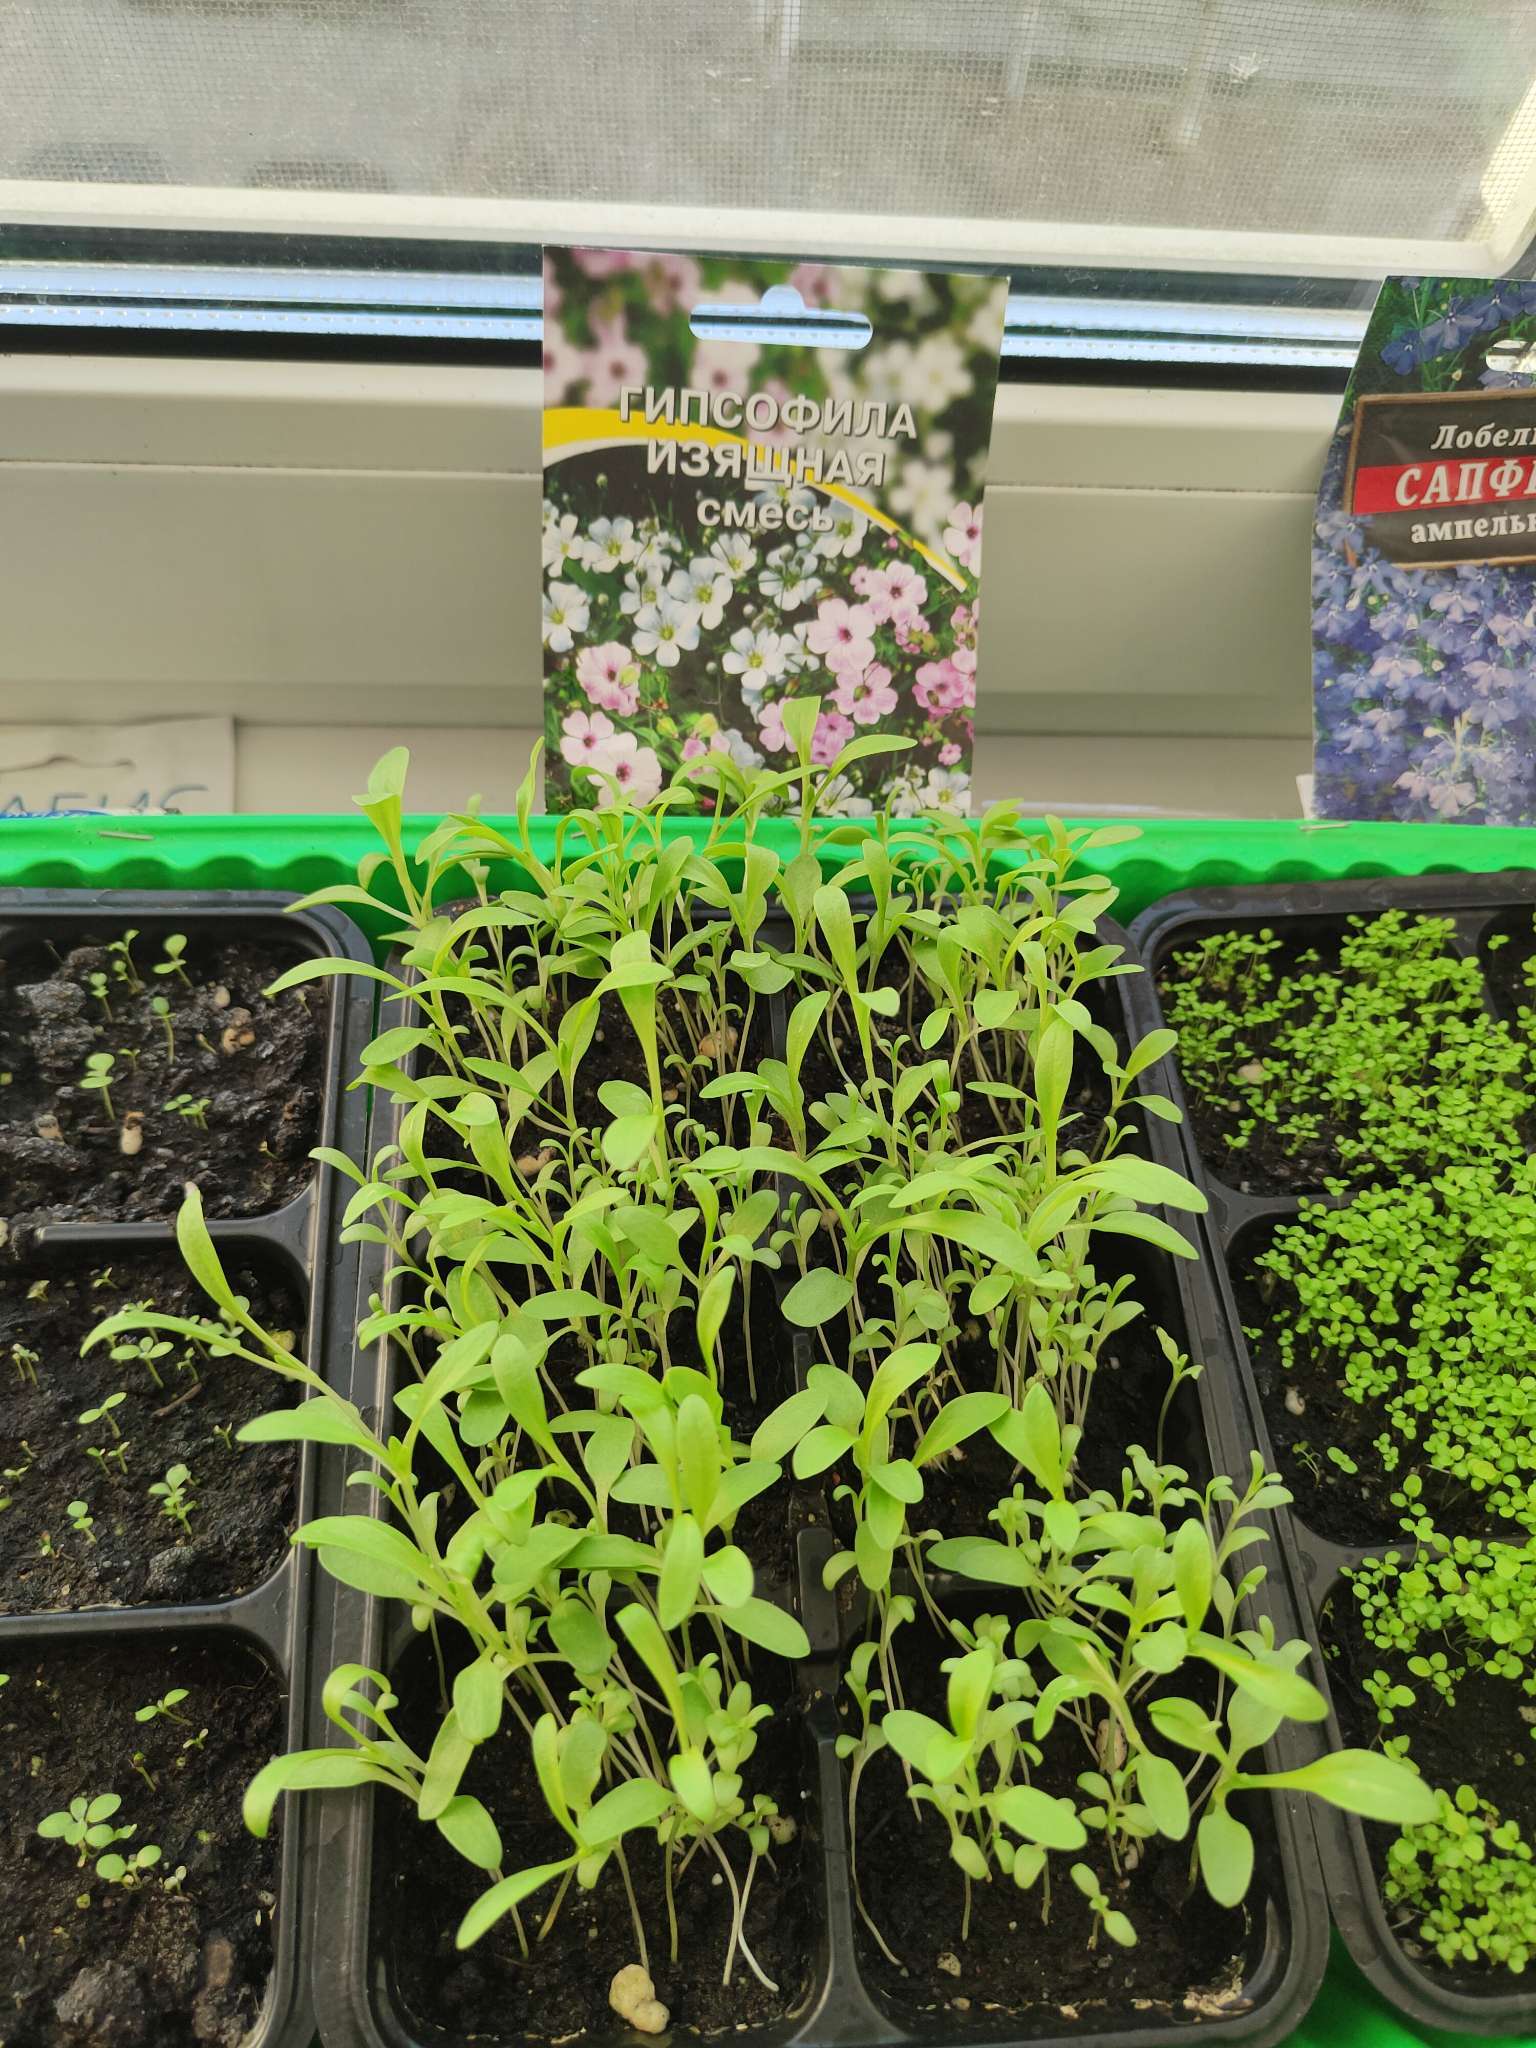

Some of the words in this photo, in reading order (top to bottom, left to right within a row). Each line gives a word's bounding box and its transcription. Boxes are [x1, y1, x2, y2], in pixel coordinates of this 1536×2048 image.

[619, 386, 918, 440] ГИПСОФИЛА
[1430, 422, 1536, 450] Лобел
[647, 439, 886, 489] ИЗЯЩНАЯ
[696, 498, 835, 534] смесь
